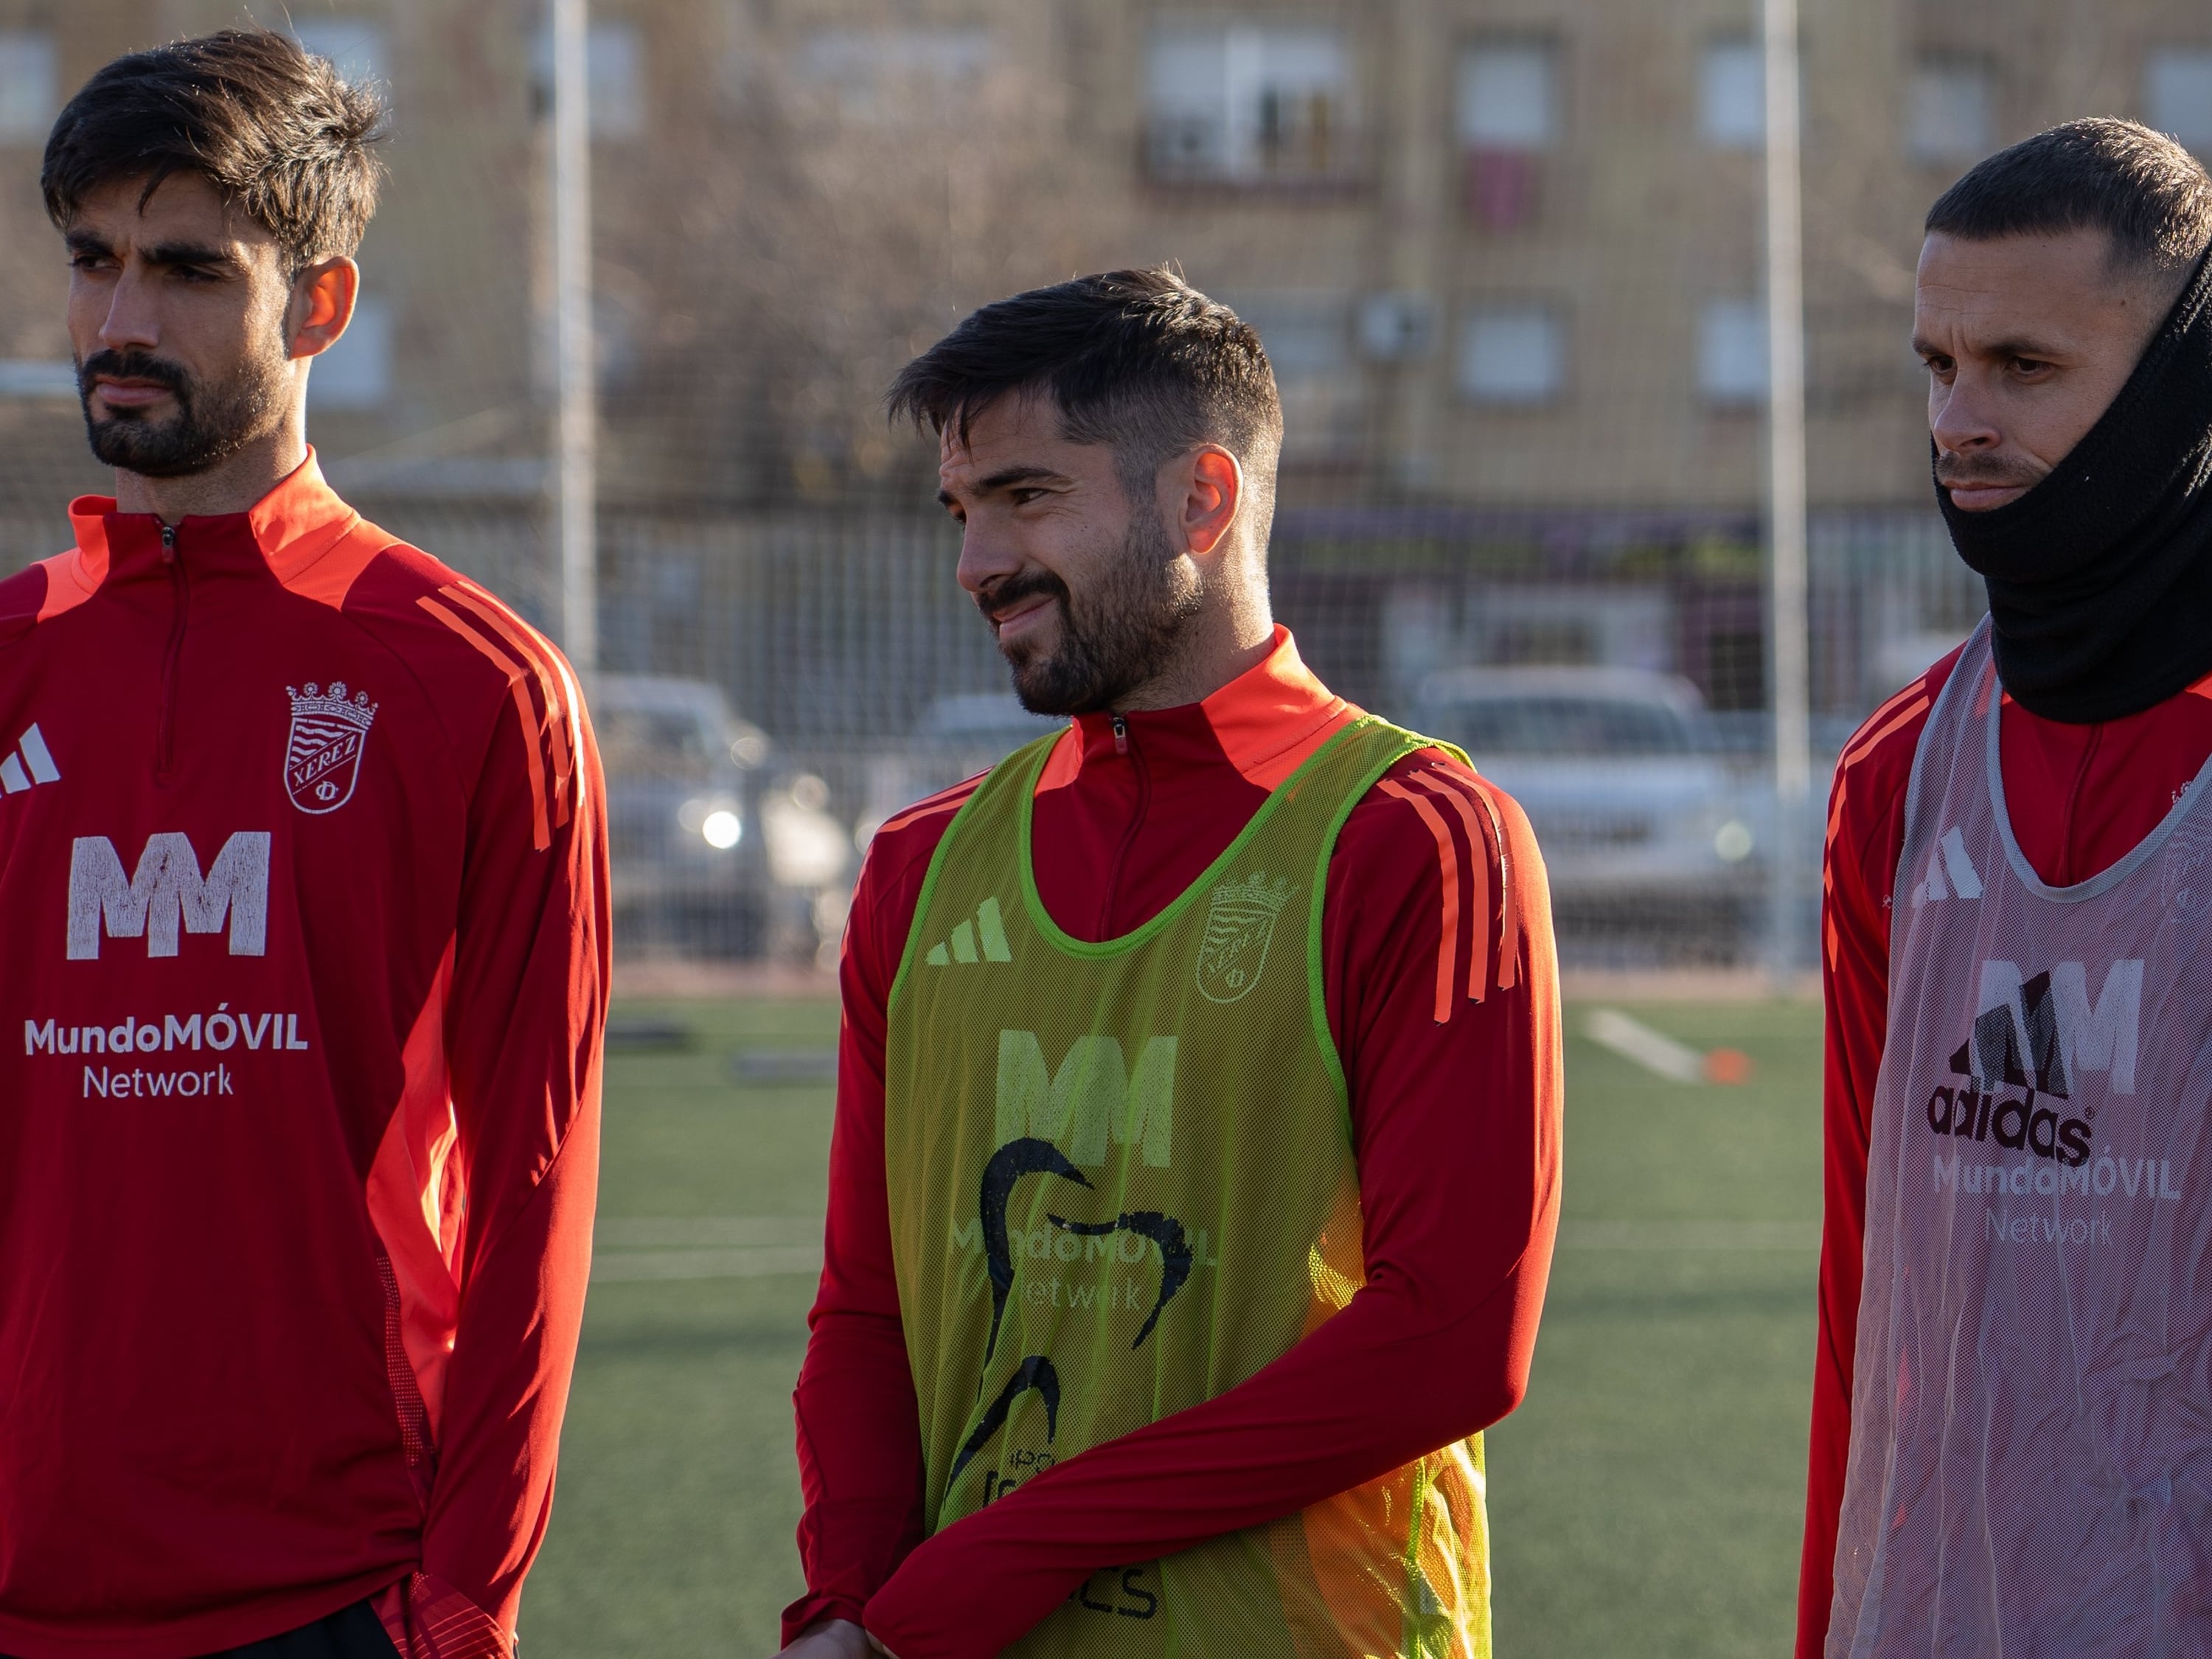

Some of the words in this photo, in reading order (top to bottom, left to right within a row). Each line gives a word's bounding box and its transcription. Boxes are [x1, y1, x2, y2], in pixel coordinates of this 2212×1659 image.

[293, 734, 357, 787] XEREZ
[66, 832, 271, 960] MM
[24, 1003, 308, 1055] MundoMÓVIL
[83, 1063, 234, 1098] Network
[995, 1029, 1178, 1168] MM
[1933, 1145, 2181, 1201] MundoMÓVIL
[1985, 1208, 2112, 1245] Network
[1016, 1275, 1141, 1311] etwrk
